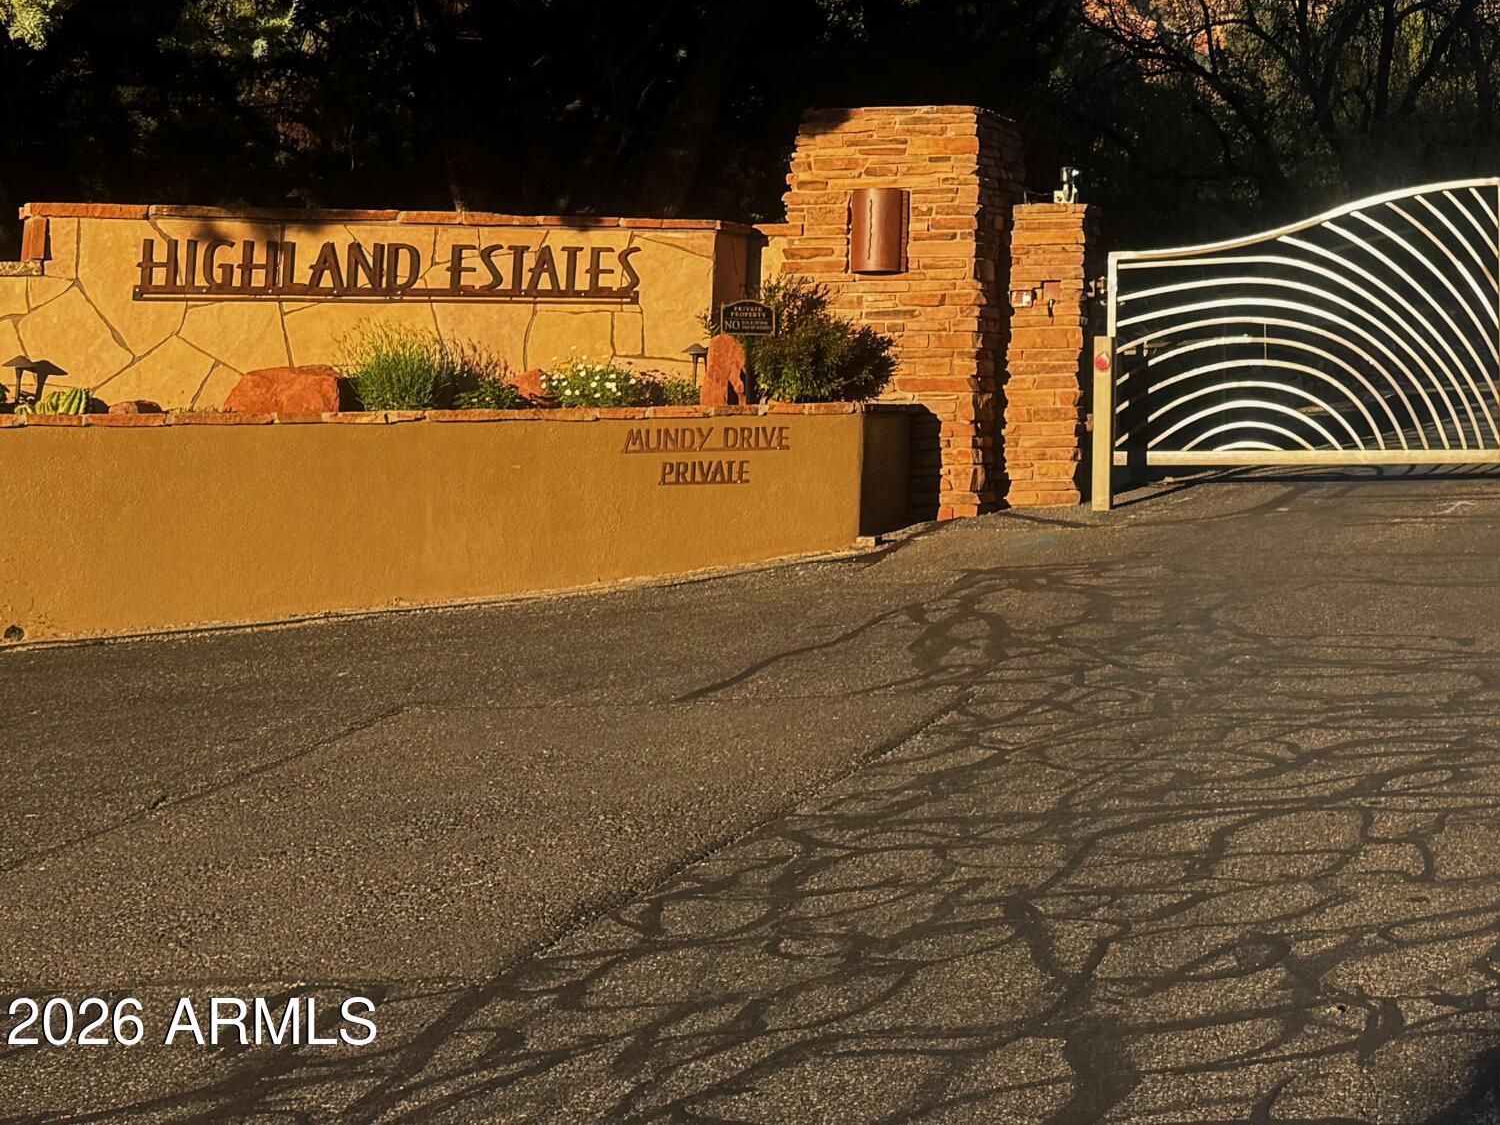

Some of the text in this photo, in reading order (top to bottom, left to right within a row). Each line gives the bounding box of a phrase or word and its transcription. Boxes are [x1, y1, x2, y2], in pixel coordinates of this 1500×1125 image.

[136, 238, 641, 291] HIGHLAND ESTATES
[724, 320, 740, 330] NO
[624, 426, 790, 452] MUNDY DRIVE
[661, 460, 750, 484] PRIVATE
